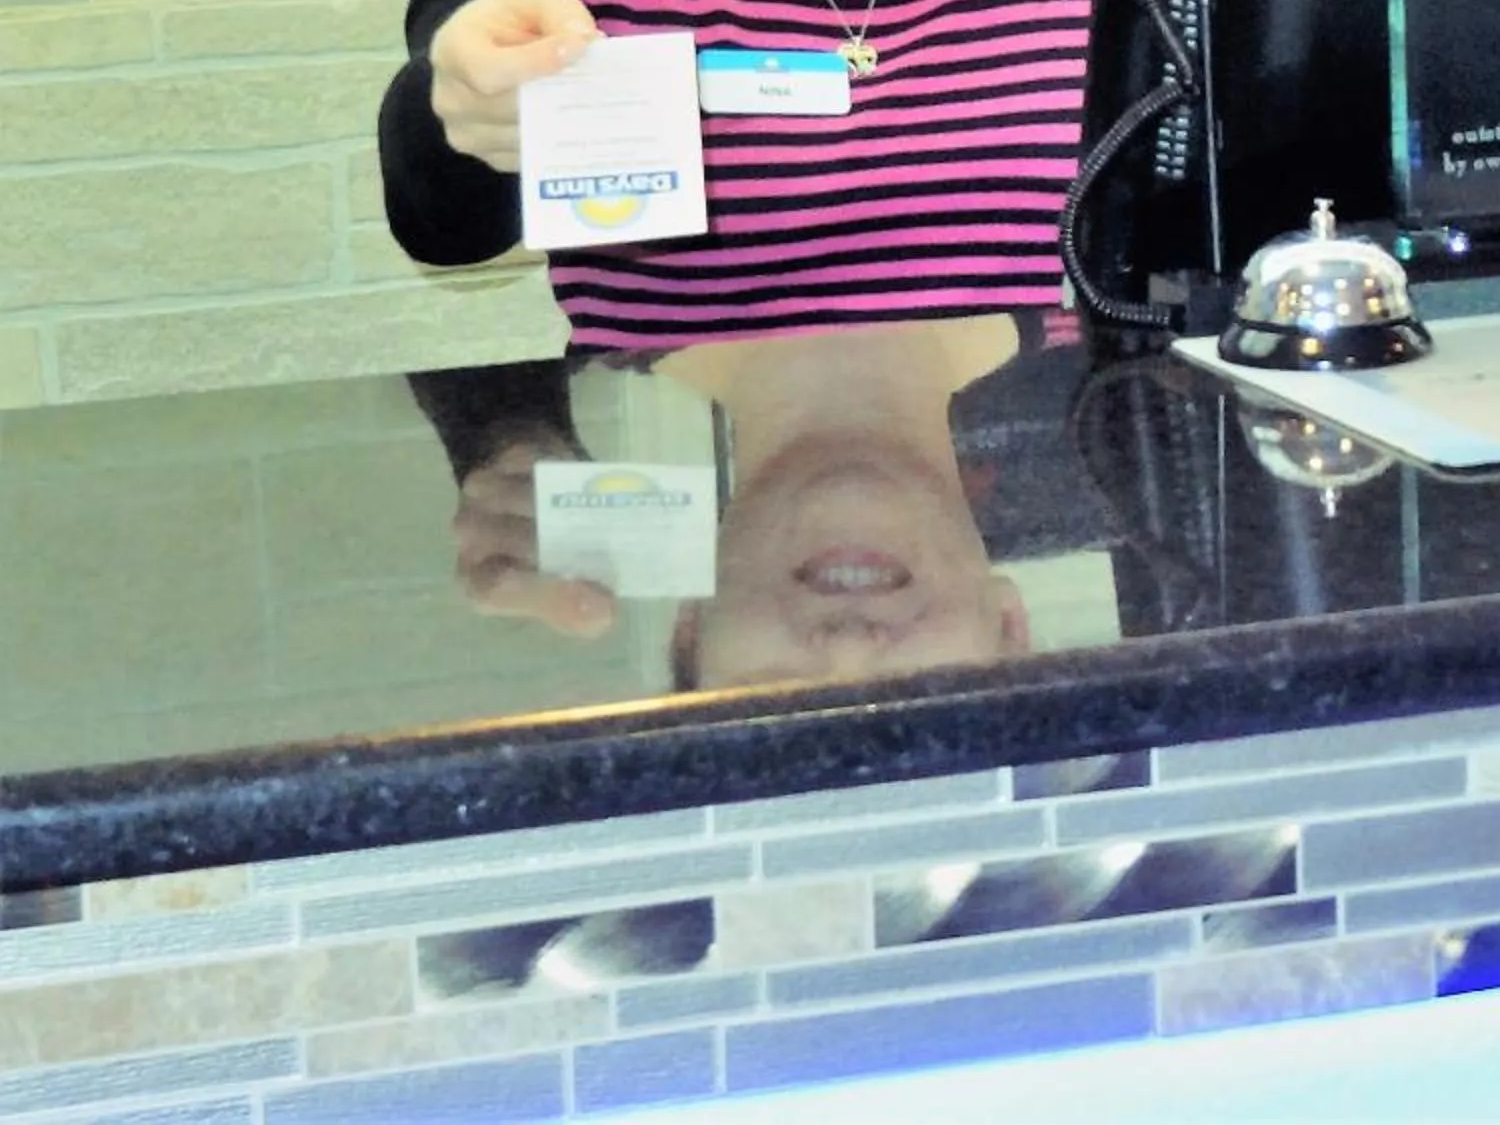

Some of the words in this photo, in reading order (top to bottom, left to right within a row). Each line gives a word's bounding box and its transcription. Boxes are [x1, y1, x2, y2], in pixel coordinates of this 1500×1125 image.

[1442, 151, 1467, 177] by
[545, 176, 596, 197] Inn
[597, 172, 672, 195] Days
